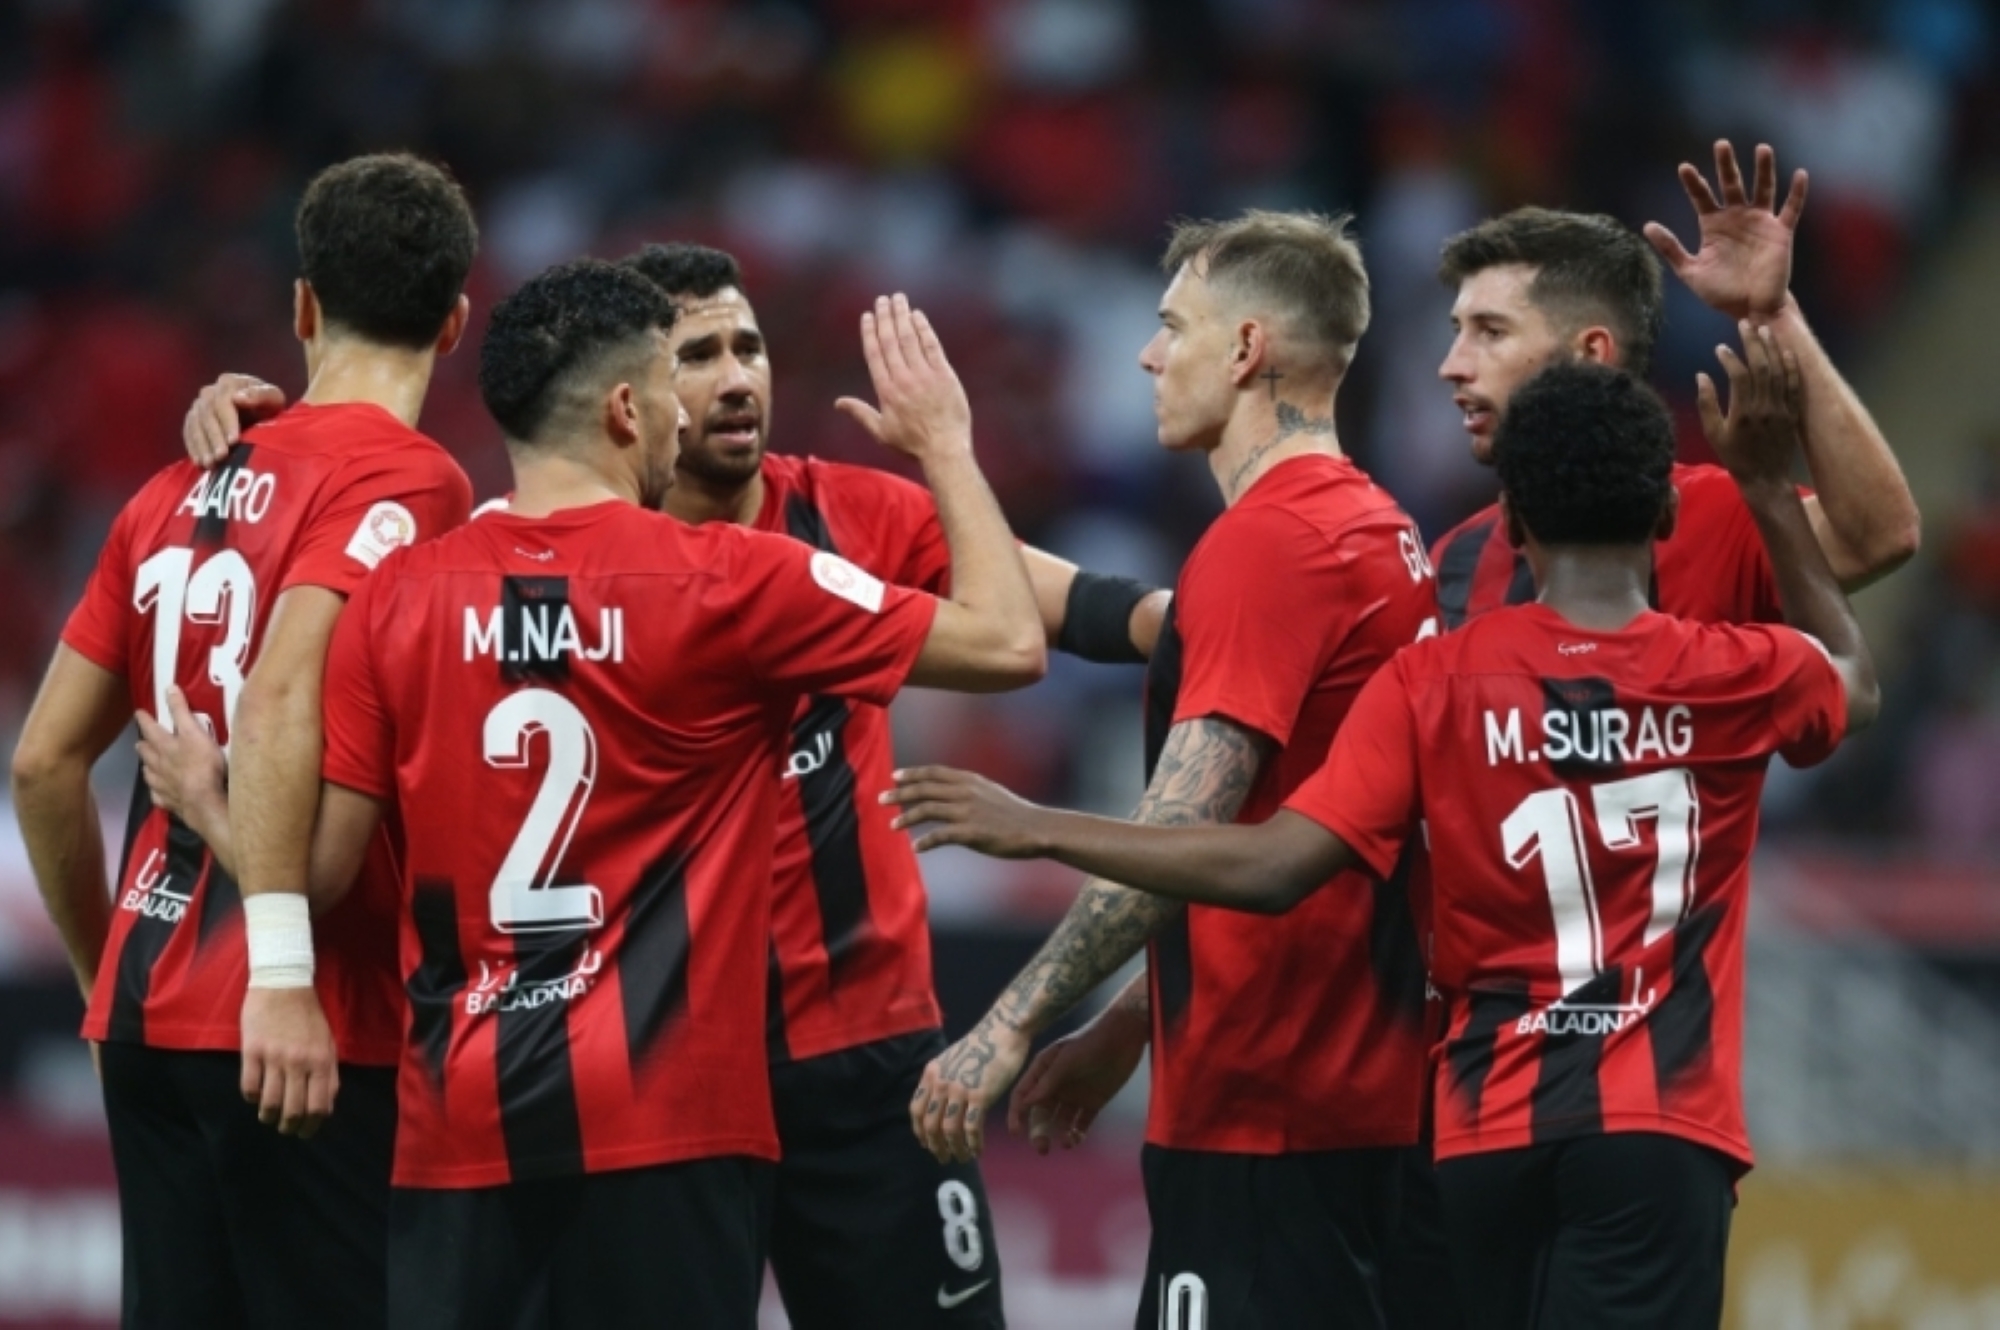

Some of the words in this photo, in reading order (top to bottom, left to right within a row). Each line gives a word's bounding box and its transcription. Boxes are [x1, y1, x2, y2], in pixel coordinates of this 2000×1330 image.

[133, 545, 256, 757] 13
[464, 605, 624, 663] M.NAJI
[481, 689, 604, 933] 2
[1484, 704, 1694, 766] M.SURAG
[1500, 767, 1701, 1003] 17
[937, 1179, 984, 1271] 8
